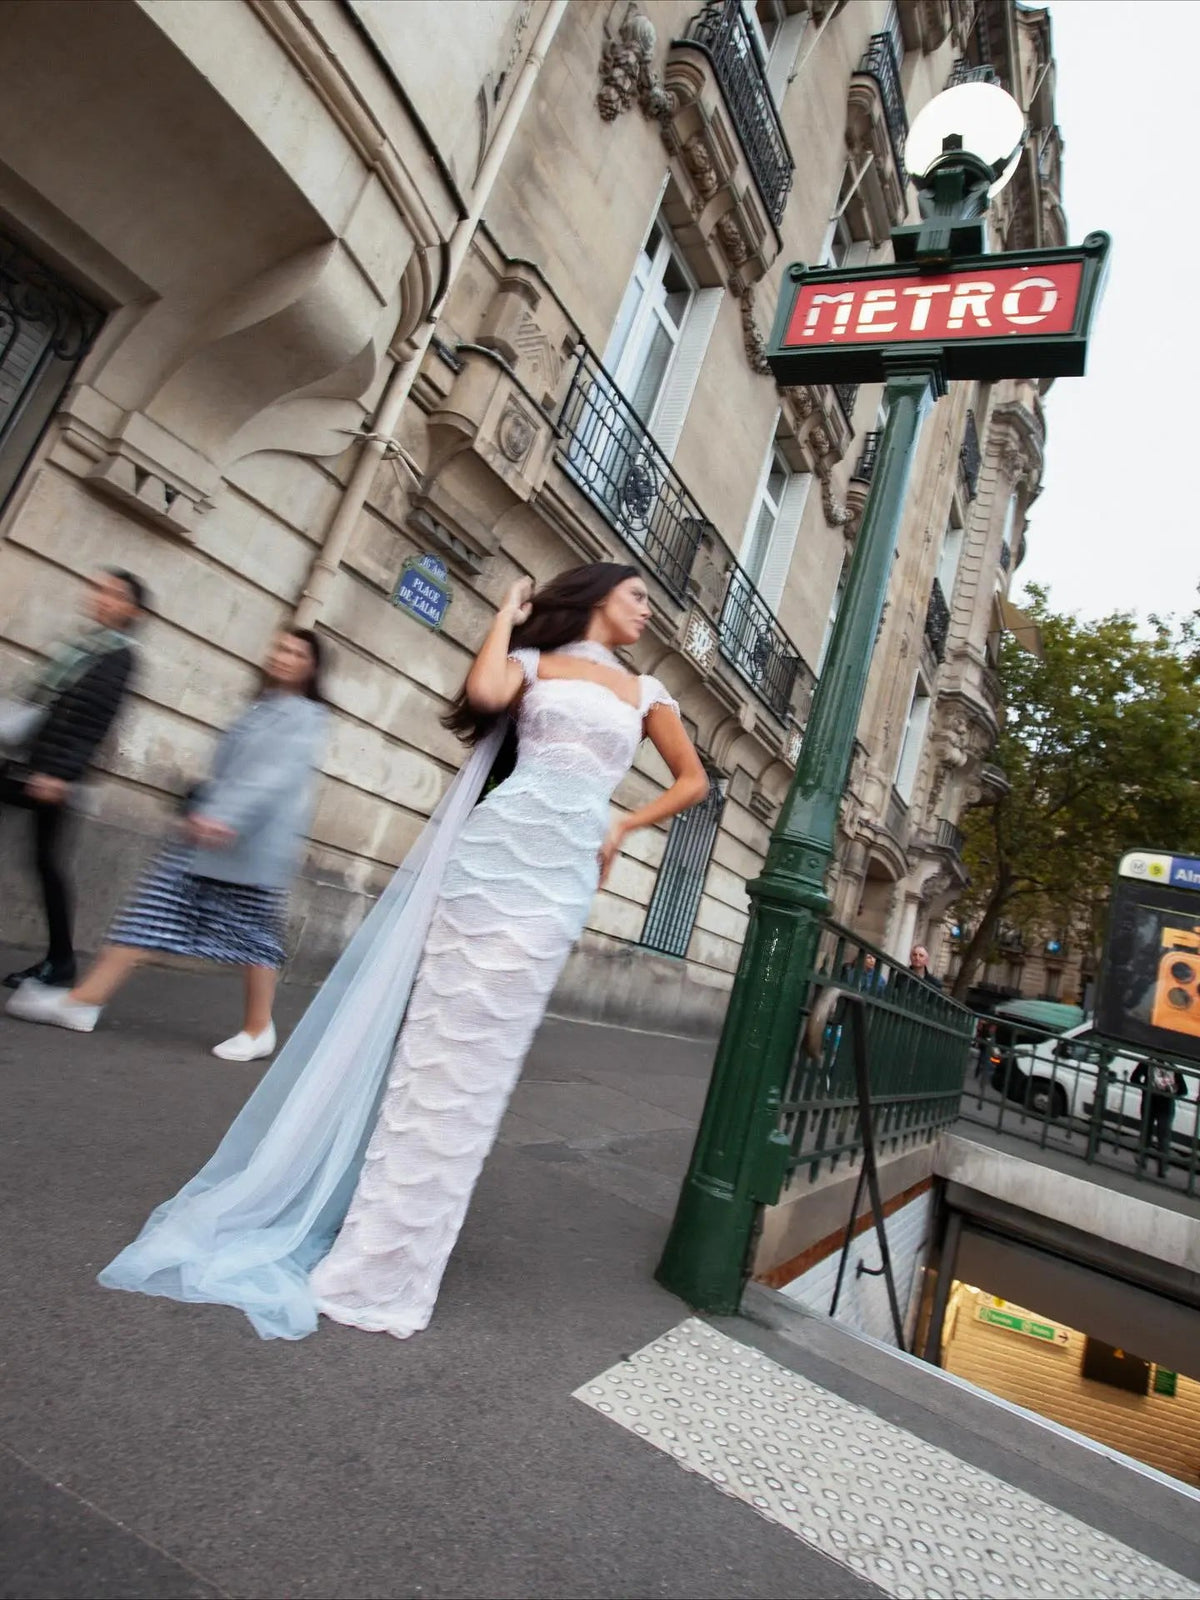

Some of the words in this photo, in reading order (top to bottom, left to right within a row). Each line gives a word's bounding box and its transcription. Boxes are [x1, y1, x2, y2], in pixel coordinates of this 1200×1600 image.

[802, 277, 1058, 336] METRO
[400, 586, 413, 601] DE
[413, 596, 440, 621] L'ALMA
[412, 577, 440, 603] PLACE
